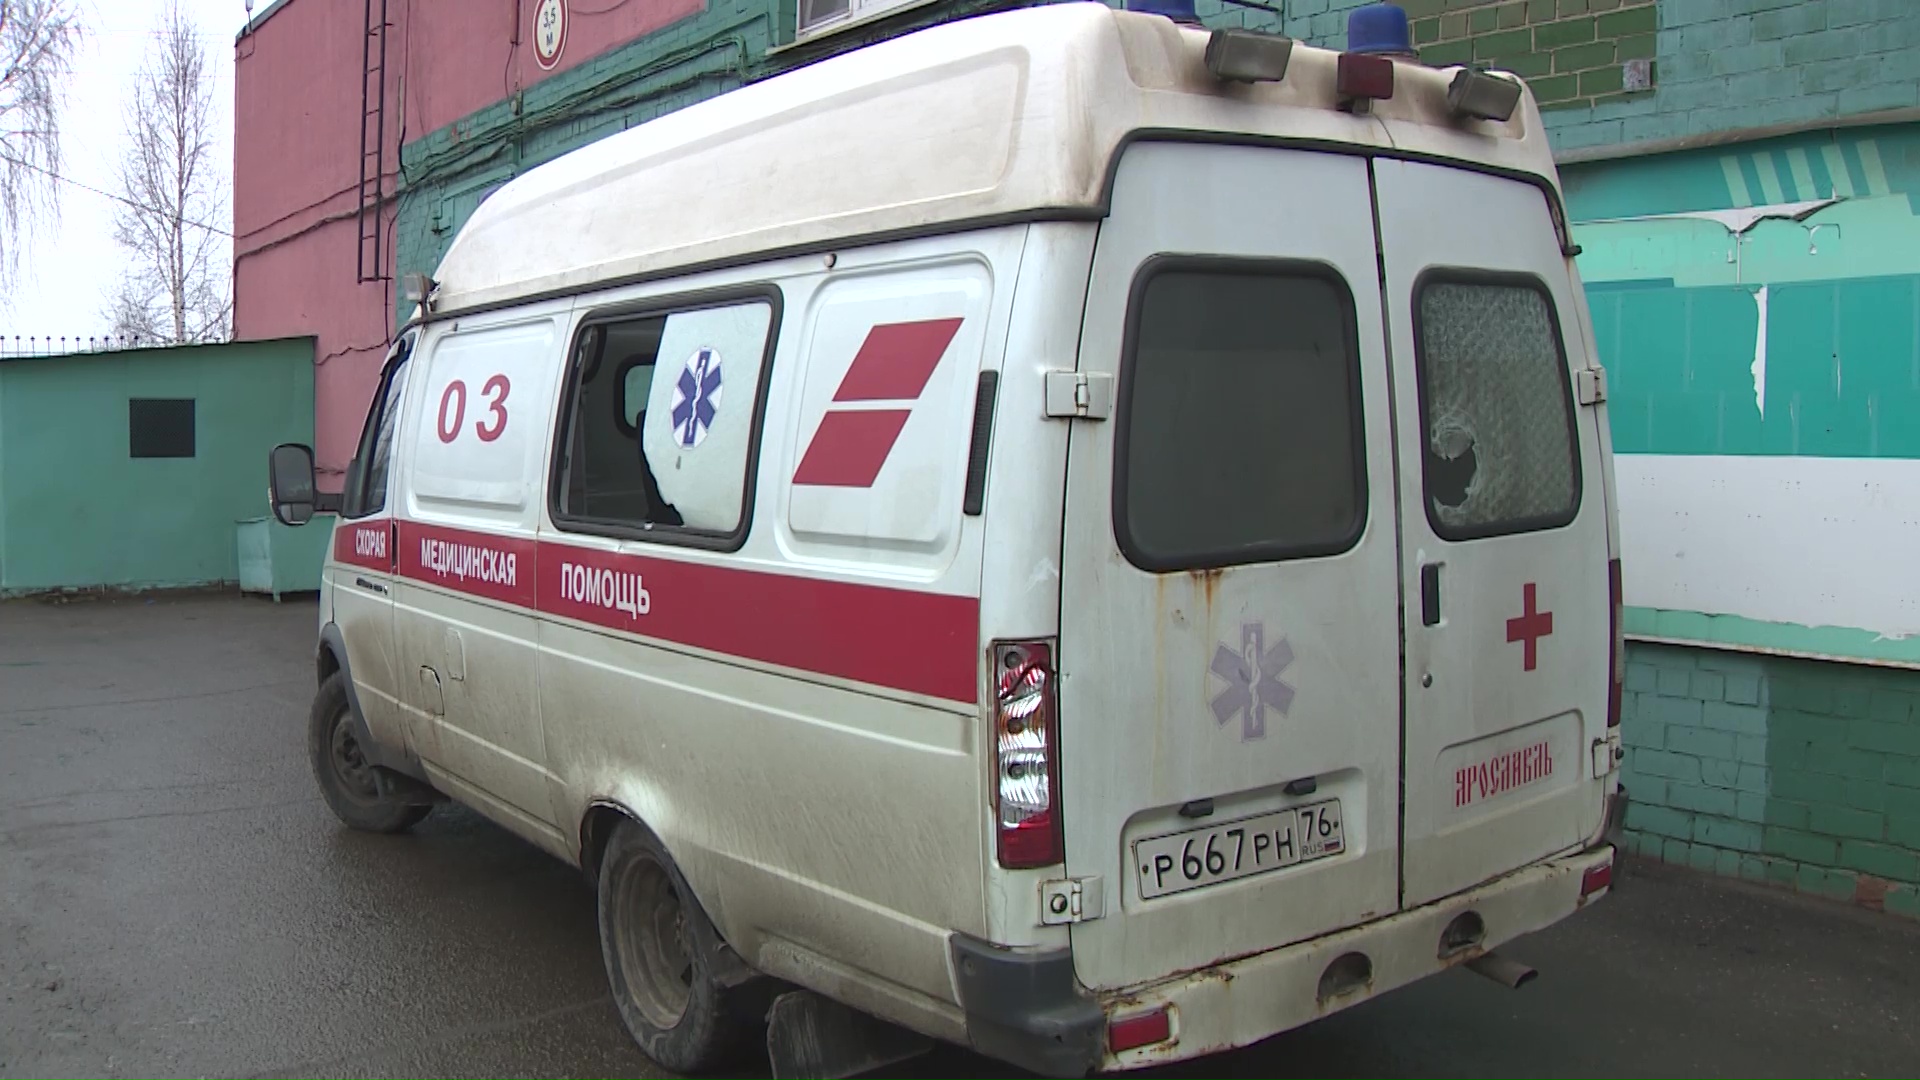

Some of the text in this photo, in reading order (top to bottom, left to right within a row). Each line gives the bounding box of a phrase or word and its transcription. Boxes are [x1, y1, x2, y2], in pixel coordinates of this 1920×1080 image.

[355, 528, 651, 620] СКОРАЯ МЕДИЦИНСКАЯ ПОМОЩЬ
[1456, 741, 1552, 808] ЯРОСЛАВЛЬ
[1301, 807, 1331, 841] 76
[1302, 841, 1323, 856] RUS
